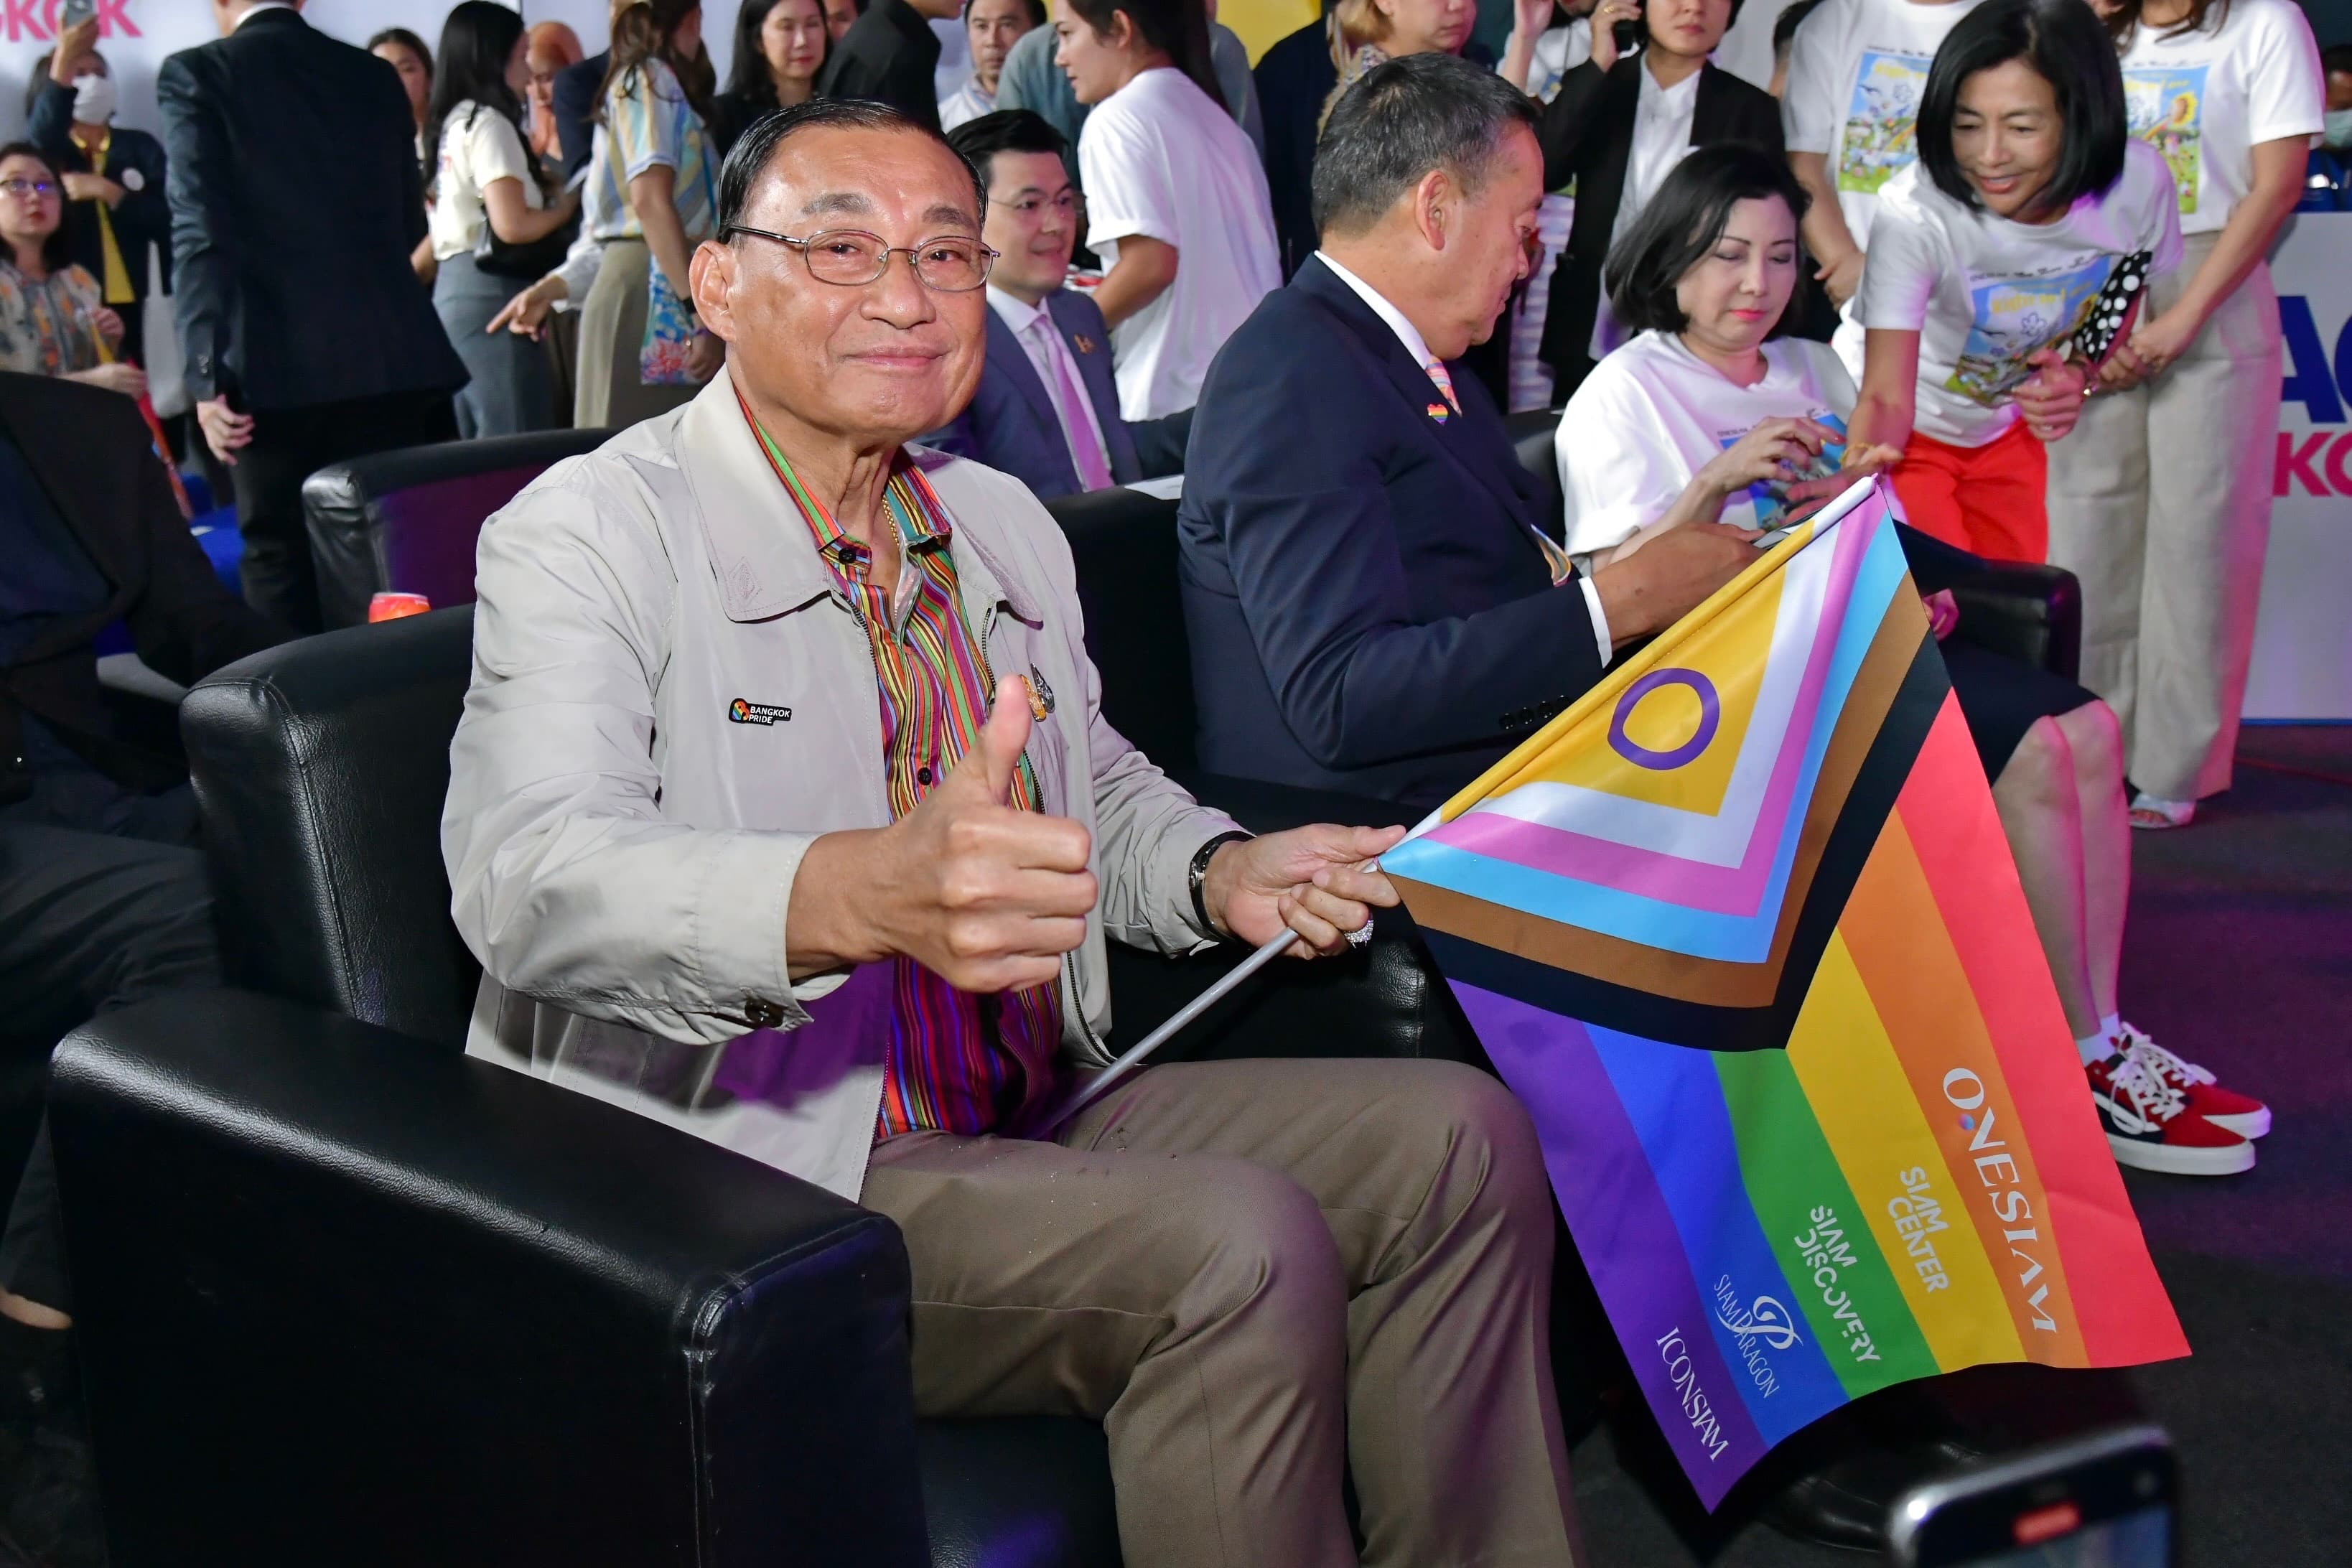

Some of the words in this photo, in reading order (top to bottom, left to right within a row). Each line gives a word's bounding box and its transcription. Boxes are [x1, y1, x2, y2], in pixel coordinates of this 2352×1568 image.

[748, 714, 773, 724] PRIDE
[750, 706, 790, 717] BANGKOK
[1810, 1205, 1857, 1267] SIAM
[1900, 1166, 1949, 1233] SIAM
[1887, 1197, 1949, 1293] CENTER
[1794, 1228, 1881, 1362] DISCOVERY
[1714, 1274, 1742, 1323] SIAM
[1732, 1309, 1780, 1398] PARAGON
[1656, 1327, 1729, 1462] ICONSIAM
